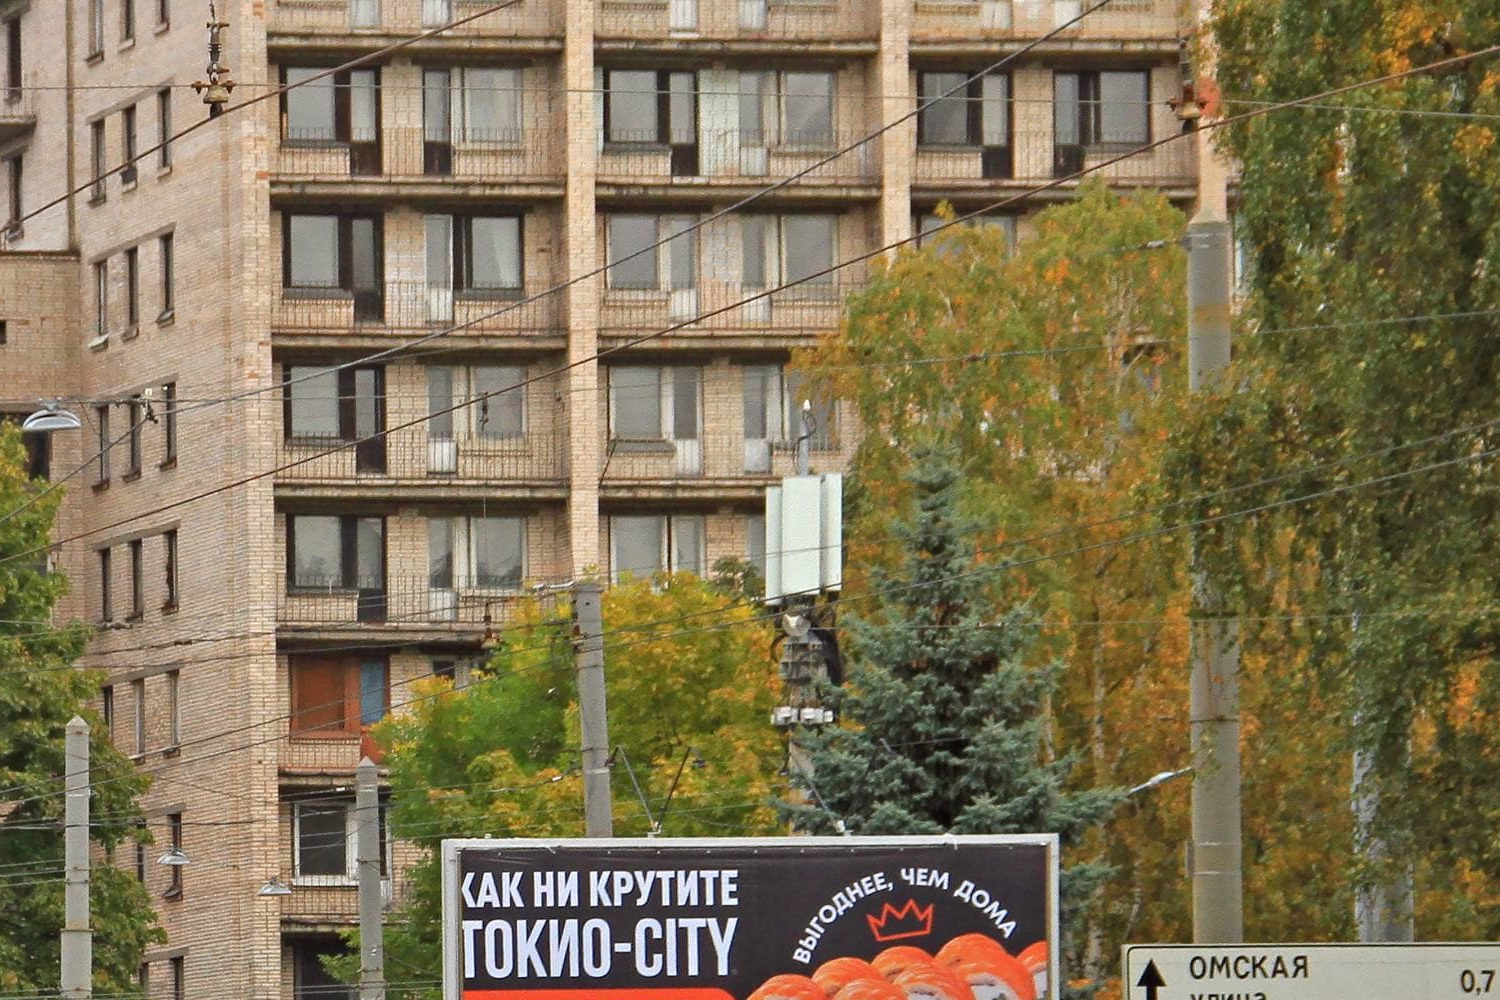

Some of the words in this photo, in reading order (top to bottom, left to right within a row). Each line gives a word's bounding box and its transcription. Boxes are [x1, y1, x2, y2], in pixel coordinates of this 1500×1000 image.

[461, 872, 525, 908] КАК
[533, 872, 579, 908] НИ
[589, 870, 739, 906] КРУТИТЕ
[901, 868, 950, 890] ЧЕМ
[953, 880, 1018, 940] ДОМА
[1189, 955, 1309, 980] ОМСКАЯ
